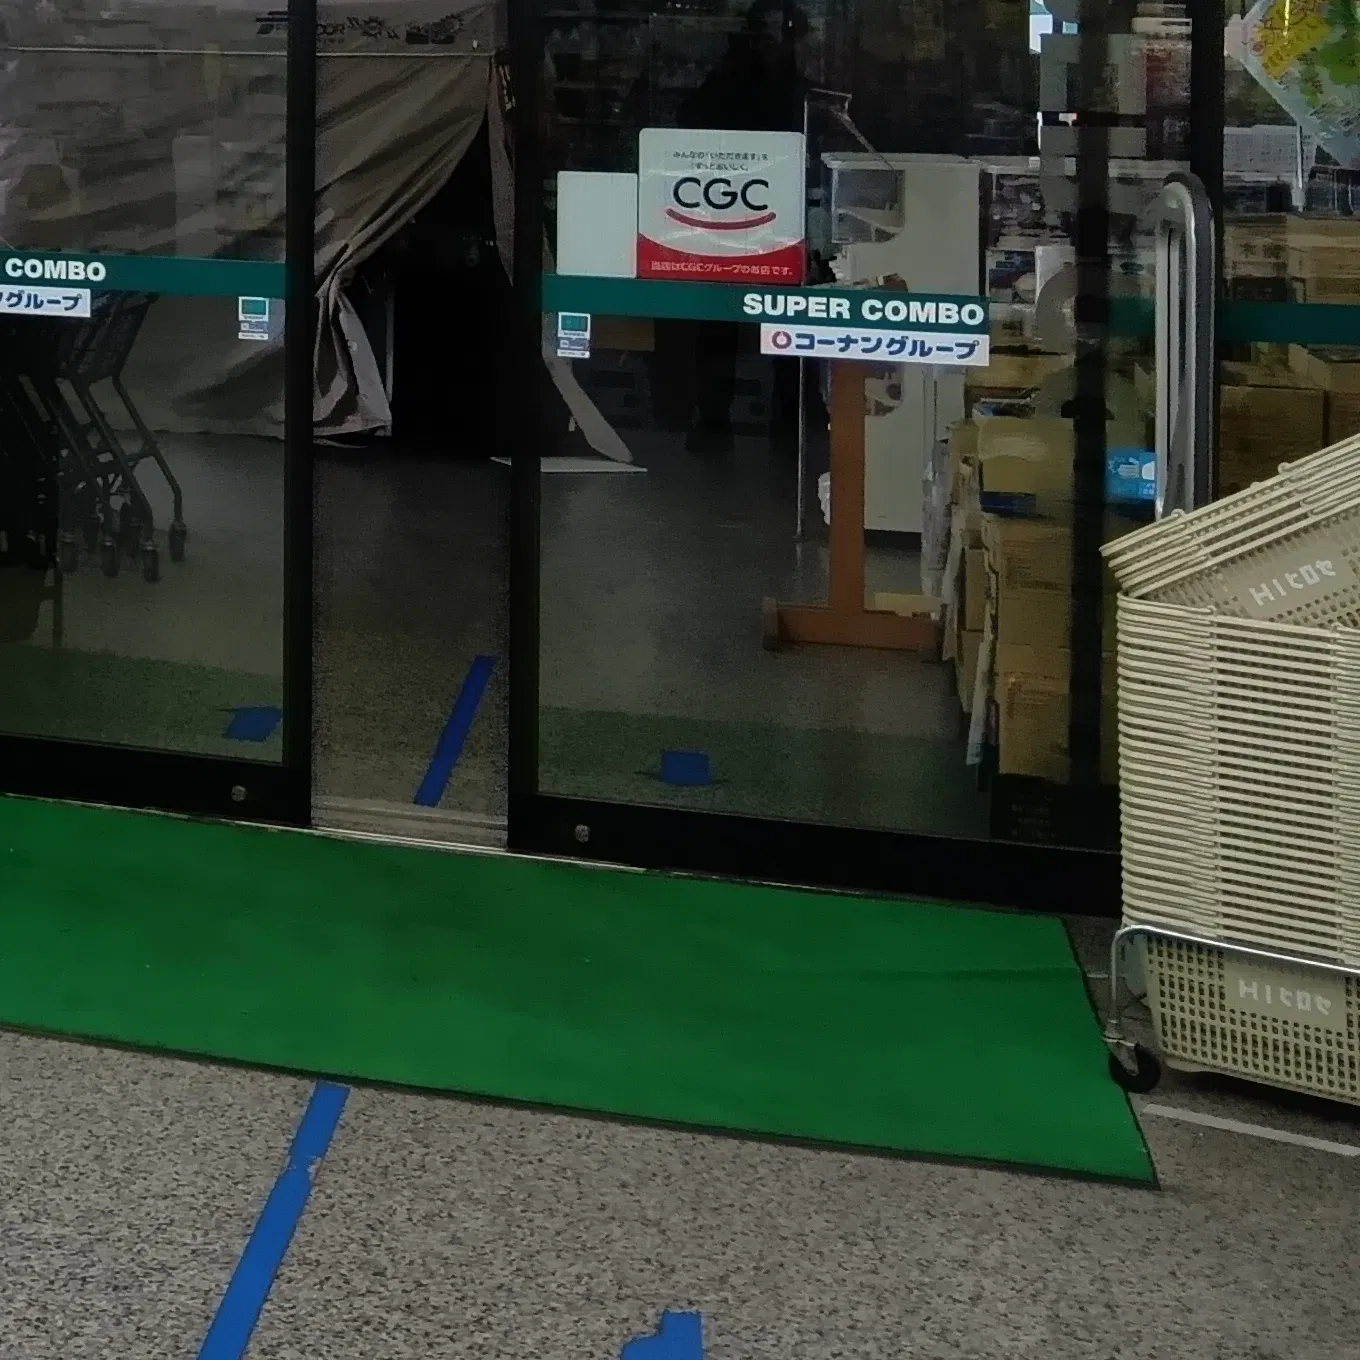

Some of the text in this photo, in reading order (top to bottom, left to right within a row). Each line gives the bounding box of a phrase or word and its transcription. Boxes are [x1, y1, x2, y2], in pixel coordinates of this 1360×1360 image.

[673, 177, 770, 211] CGC
[5, 256, 107, 282] COMBO
[742, 292, 986, 326] SUPER COMBO
[794, 331, 981, 361] コーナングループ
